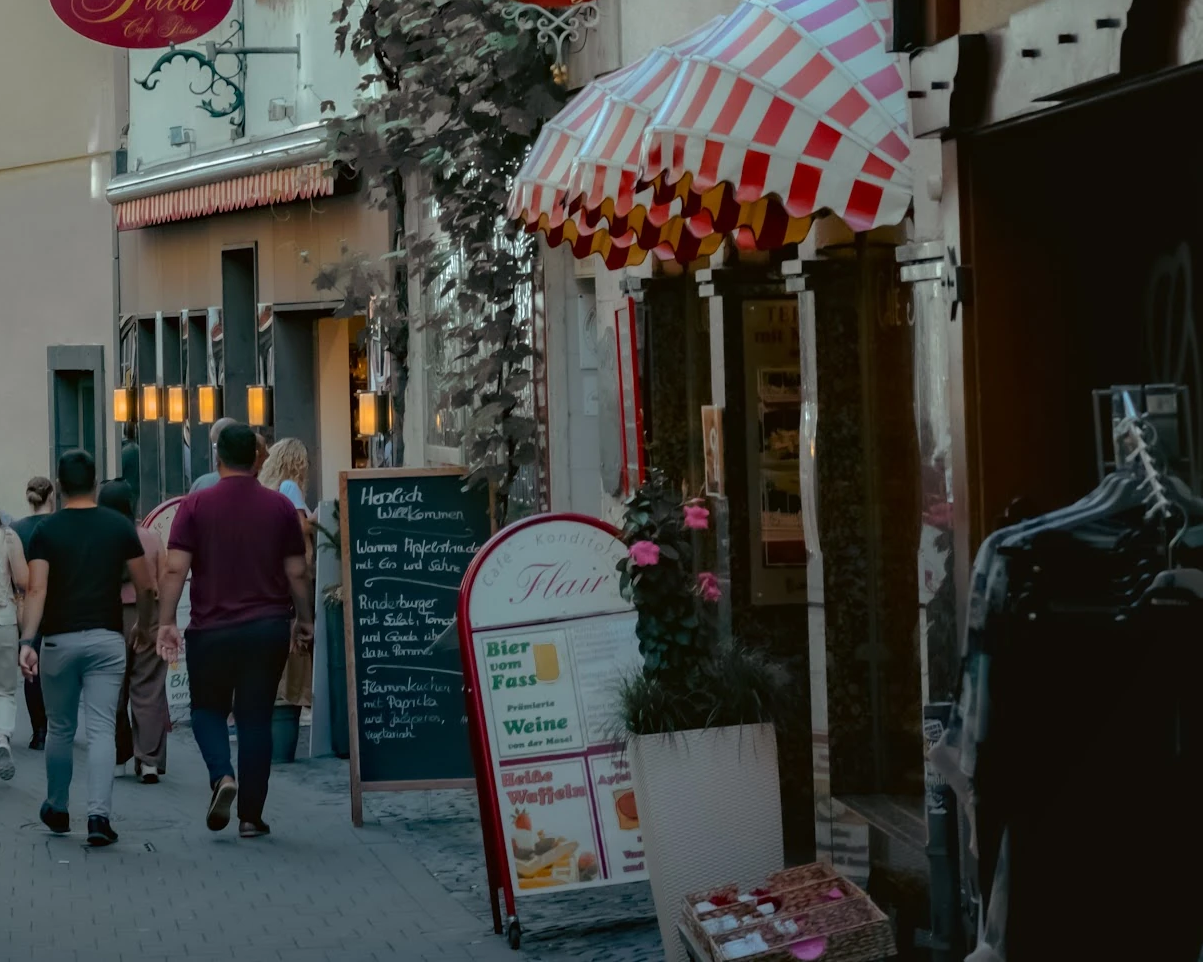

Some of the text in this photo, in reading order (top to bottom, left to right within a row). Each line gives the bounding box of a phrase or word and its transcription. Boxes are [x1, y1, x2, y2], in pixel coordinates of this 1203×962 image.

[361, 486, 424, 505] Herzlich
[404, 538, 481, 558] Apfelstrude
[535, 531, 621, 562] Konditore
[355, 557, 461, 573] mit Eis und Sahne
[508, 559, 610, 605] Flair
[359, 612, 380, 627] mit
[486, 641, 530, 657] Bier
[489, 659, 522, 672] vom
[491, 674, 538, 691] Fass
[502, 716, 568, 736] Weine
[506, 783, 587, 807] Waffeln
